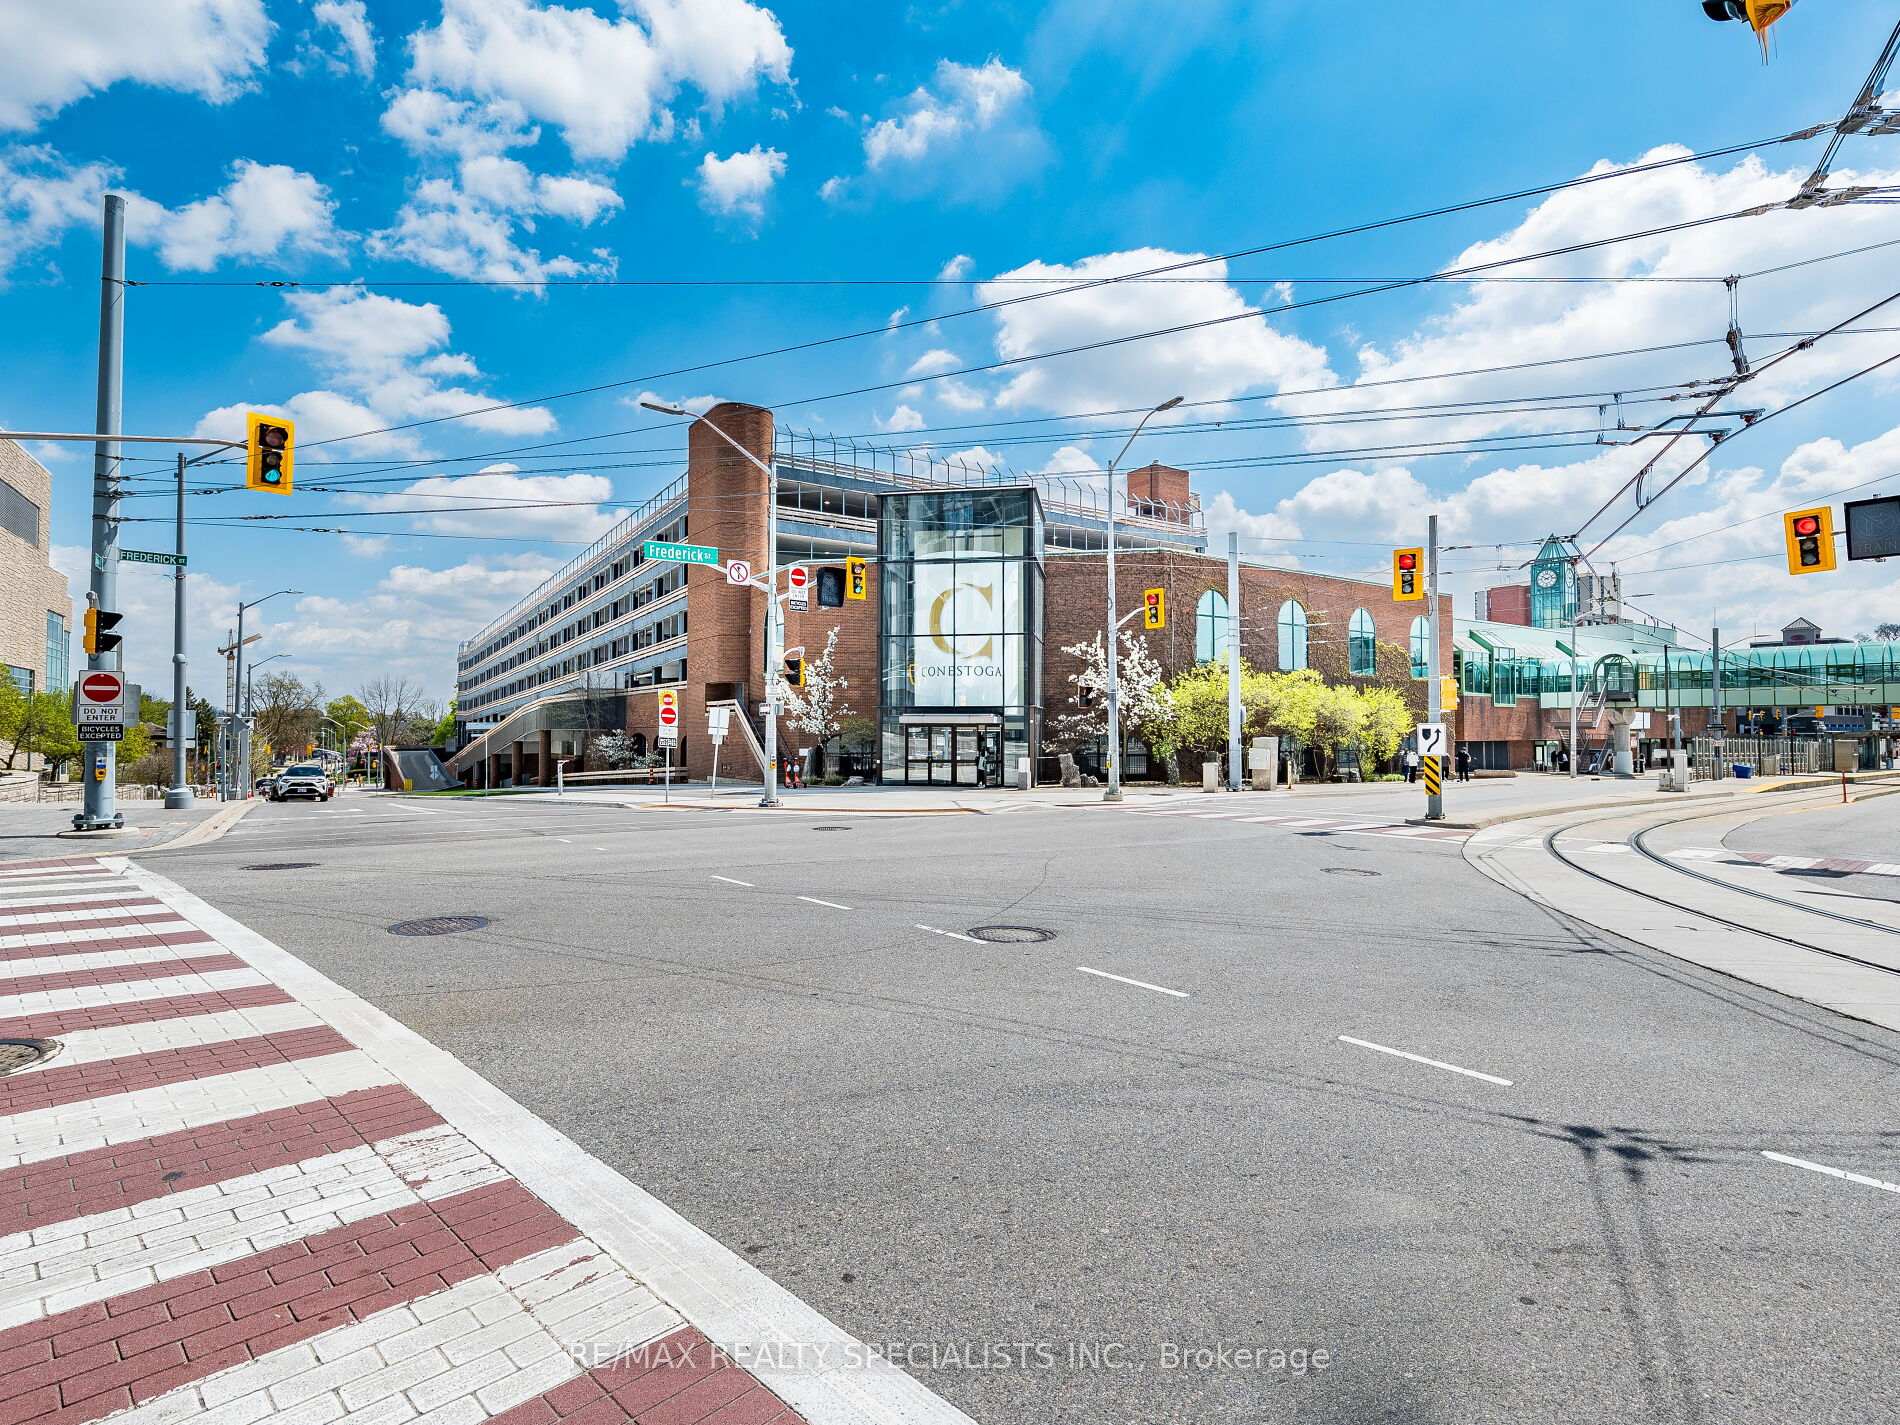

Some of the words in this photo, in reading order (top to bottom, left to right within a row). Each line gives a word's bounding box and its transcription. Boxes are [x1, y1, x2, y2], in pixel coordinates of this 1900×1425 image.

[121, 550, 176, 564] FREDERICK
[649, 544, 703, 562] Frederick
[929, 582, 993, 662] C
[921, 665, 1002, 677] CONESTOGA
[81, 725, 120, 733] BICYCLES
